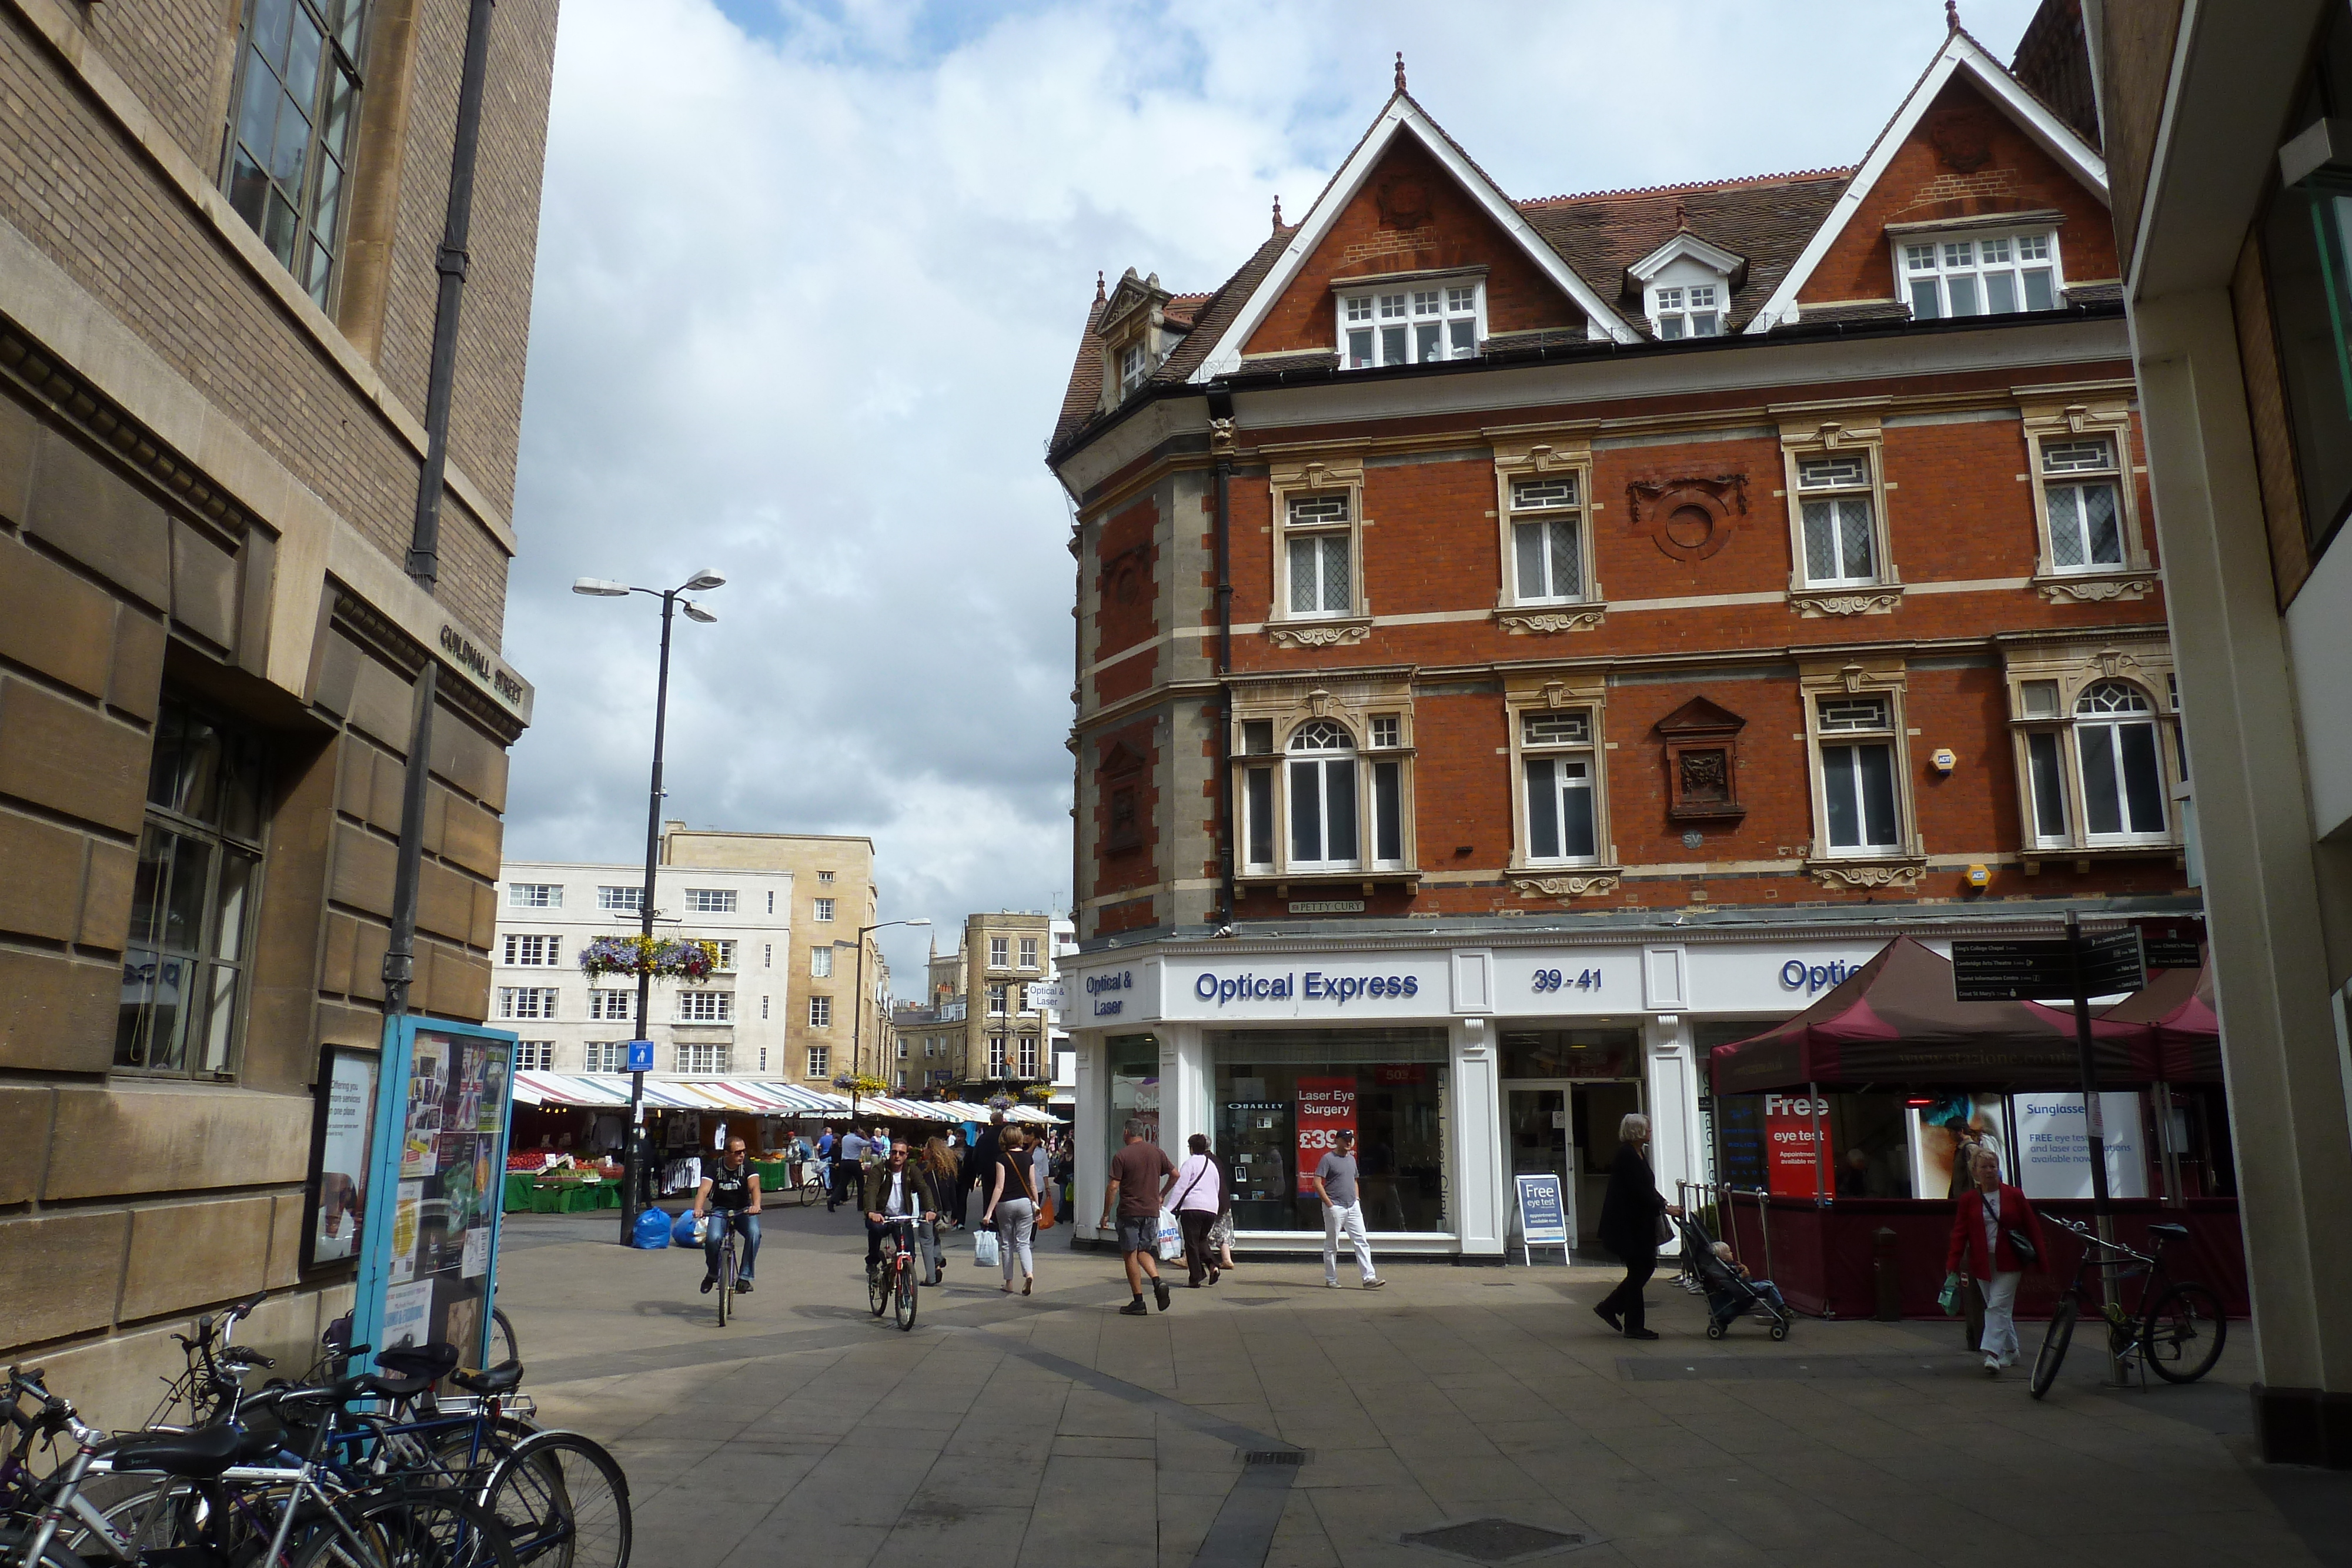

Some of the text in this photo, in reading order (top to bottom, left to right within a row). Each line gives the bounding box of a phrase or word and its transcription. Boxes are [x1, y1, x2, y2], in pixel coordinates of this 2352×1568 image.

[440, 624, 523, 707] GUILDHALL STREET
[1684, 834, 1700, 843] SV
[1300, 901, 1362, 911] PETTY CURY
[1087, 971, 1131, 997] Optical &
[1196, 971, 1419, 1004] Optical Express
[1030, 986, 1057, 996] Optical
[1037, 997, 1058, 1005] Laser
[1094, 999, 1122, 1016] Laser
[349, 1084, 358, 1092] you
[1135, 1091, 1160, 1112] Sale
[1298, 1090, 1355, 1103] Laser Eye
[343, 1106, 356, 1116] place
[1304, 1103, 1350, 1116] Surgery
[1765, 1094, 1829, 1116] Free
[2026, 1104, 2086, 1116] Sunglasse
[1299, 1129, 1355, 1149] £39
[1438, 1116, 1447, 1168] Laser
[1773, 1130, 1825, 1144] eye test
[2030, 1134, 2052, 1142] FREE
[2054, 1135, 2070, 1144] eye
[2032, 1155, 2070, 1164] available
[1525, 1184, 1554, 1198] Free
[1440, 1175, 1449, 1230] Clinic
[1527, 1199, 1540, 1208] eye
